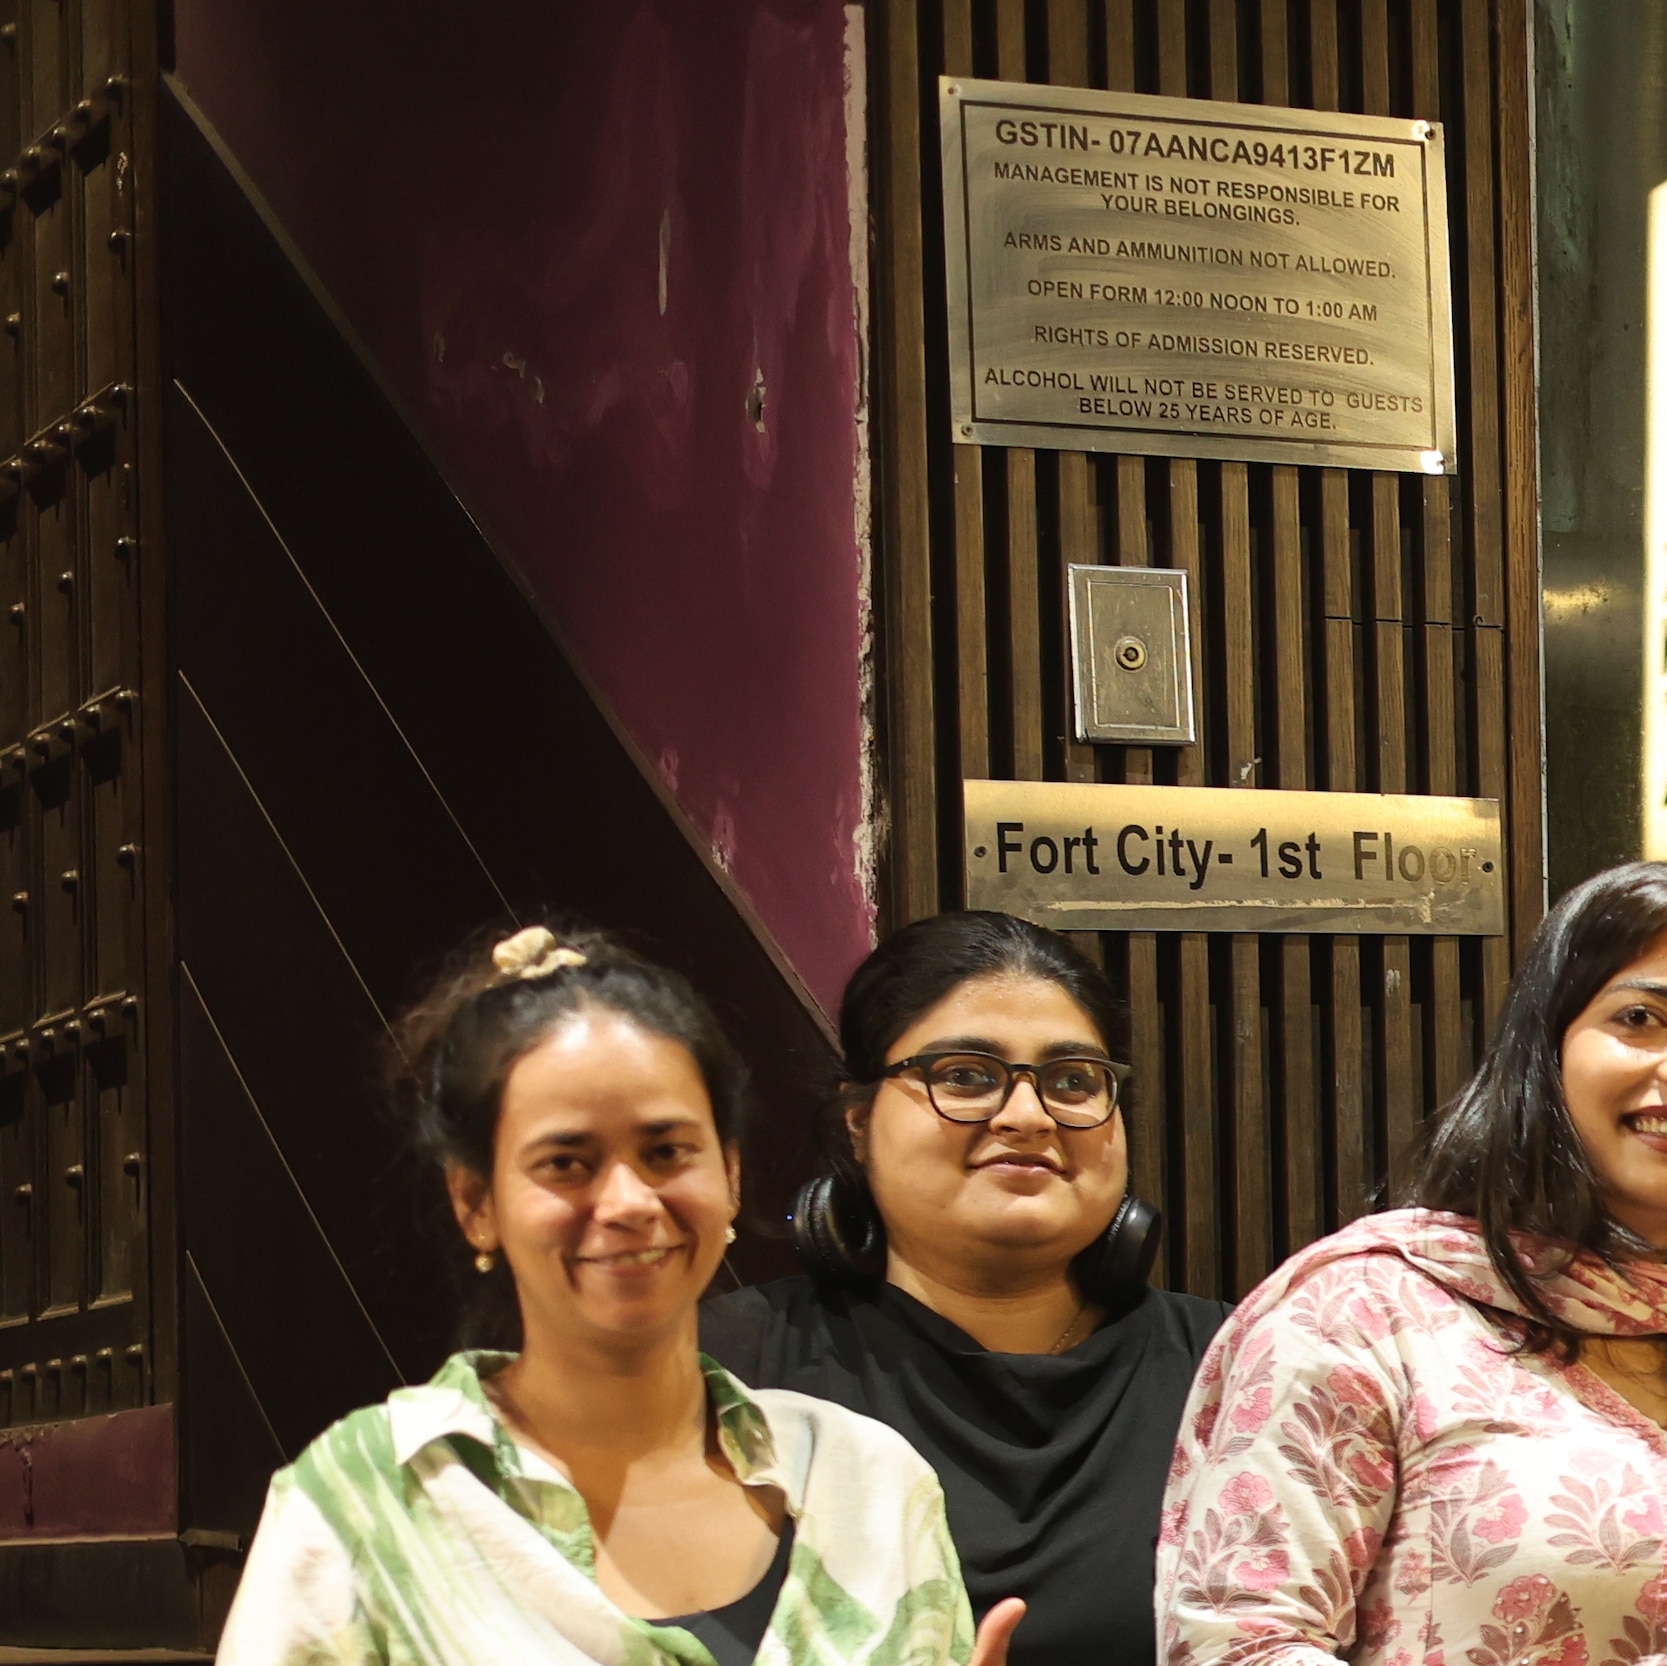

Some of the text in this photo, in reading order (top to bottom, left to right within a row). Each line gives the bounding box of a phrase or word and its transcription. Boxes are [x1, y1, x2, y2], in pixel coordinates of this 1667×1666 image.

[996, 119, 1395, 178] GSTIN- 07AANCA9413F1ZM
[994, 162, 1400, 213] MANAGEMENT IS NOT RESPONSIBLE FOR
[1100, 193, 1300, 226] YOUR BELONGINGS.
[1004, 232, 1396, 279] ARMS AND AMMUNITION NOT ALLOWED.
[1028, 280, 1377, 322] OPEN FORM 12:00 NOON TO 1:00 AM
[1035, 325, 1374, 366] RIGHTS OF ADMISSION RESERVED.
[984, 368, 1424, 414] ALCOHOL WILL NOT BE SERVED TO GUESTS
[1079, 397, 1338, 430] BELOW 25 YEARS OF AGE.
[997, 822, 1477, 890] Fort City- 1st Floor
